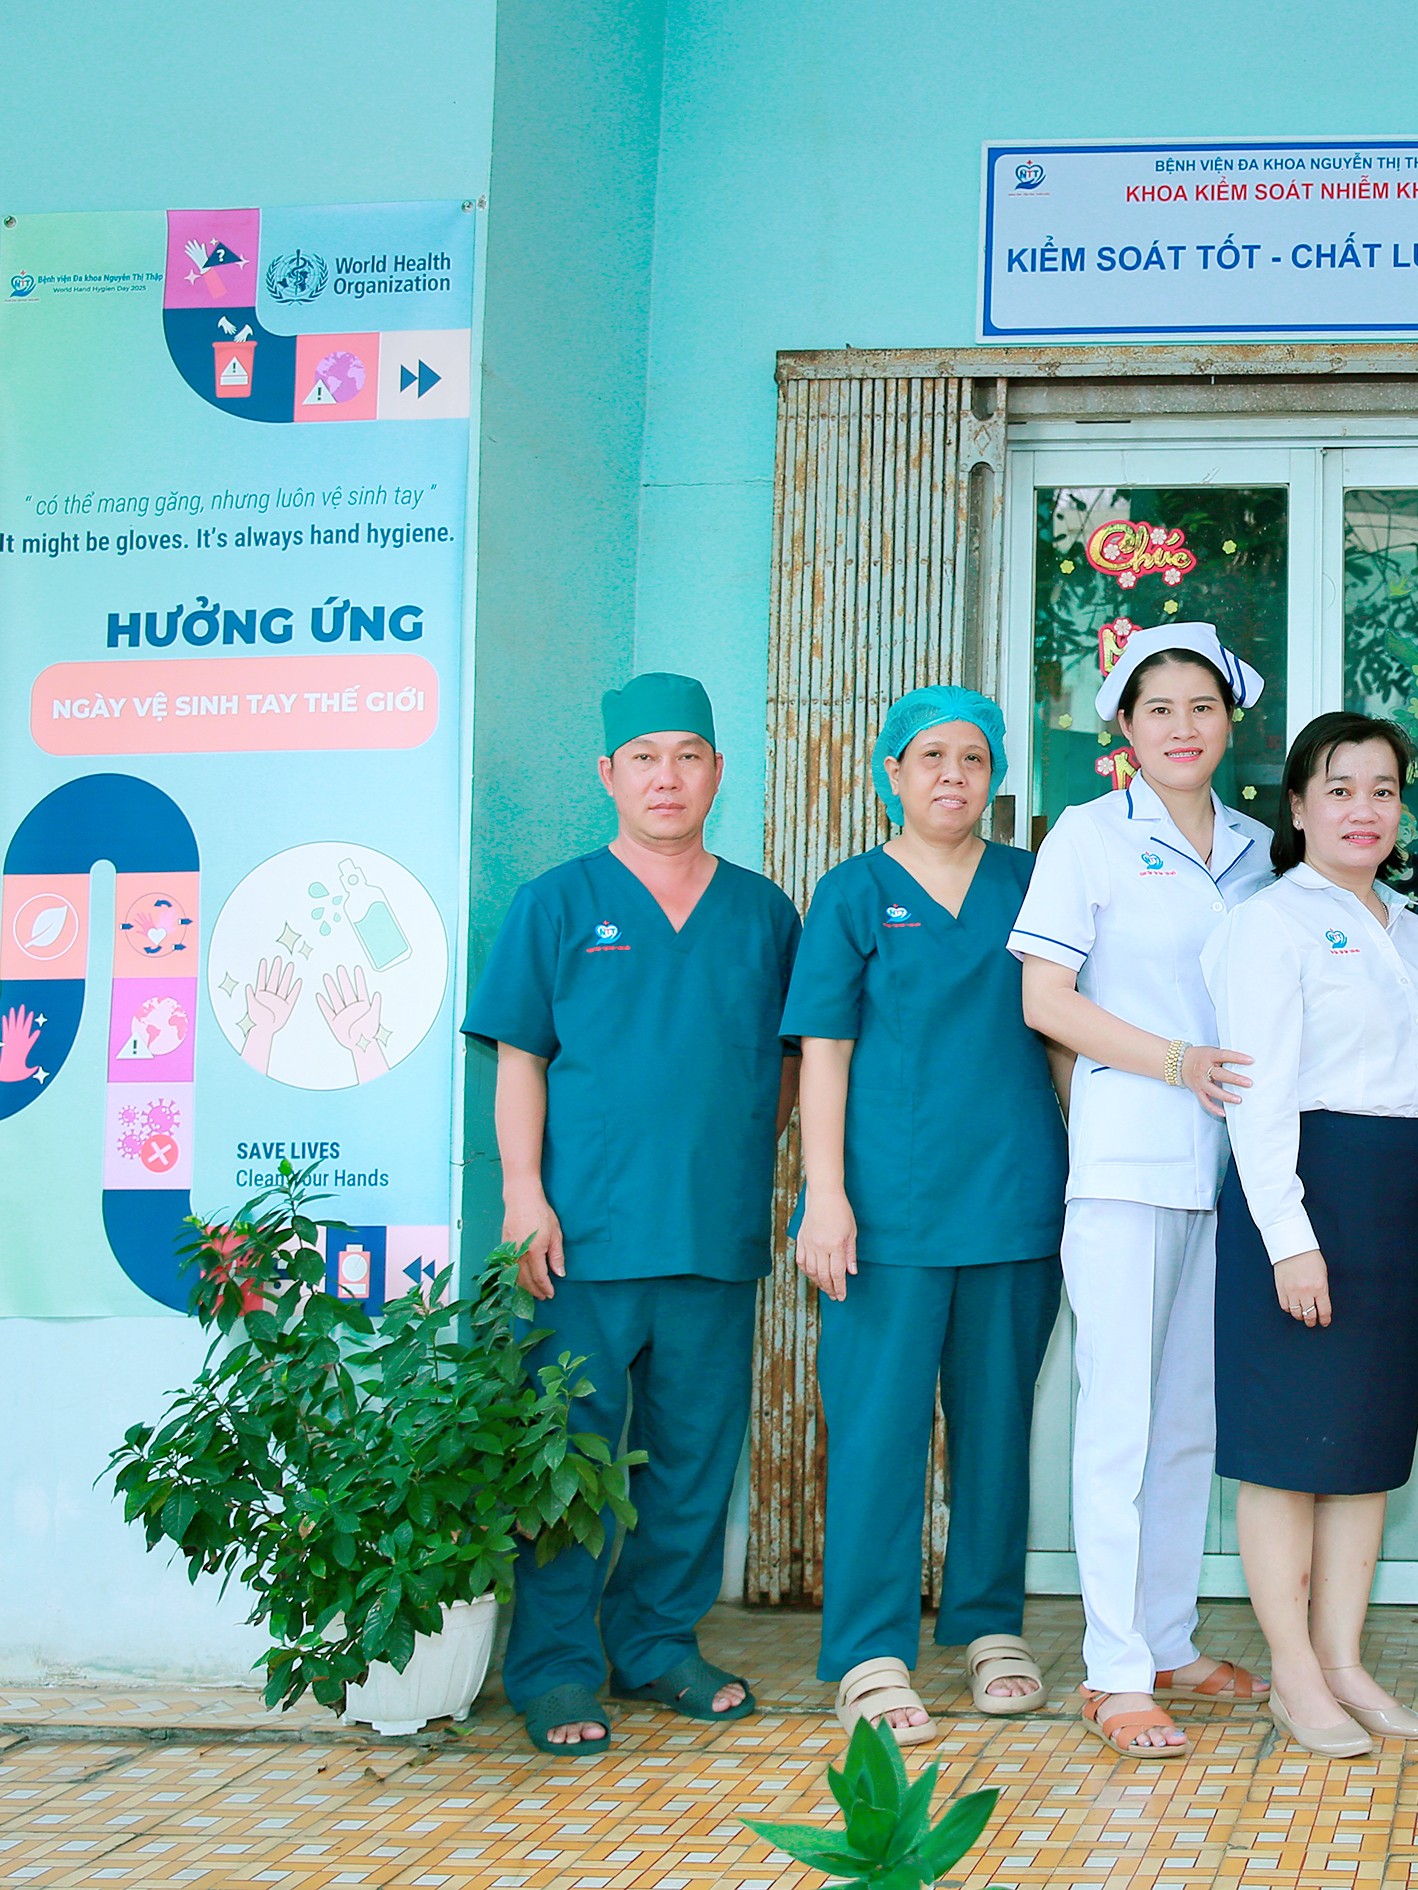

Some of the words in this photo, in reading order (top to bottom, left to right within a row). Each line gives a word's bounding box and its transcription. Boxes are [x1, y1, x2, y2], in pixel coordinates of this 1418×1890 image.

[1155, 157, 1196, 175] BỆNH
[1200, 156, 1234, 174] VIỆN
[1238, 158, 1259, 171] ĐA
[1263, 158, 1306, 171] KHOA
[1311, 153, 1373, 169] NGUYỄN
[1377, 156, 1401, 172] THỊ
[1126, 184, 1188, 202] KHOA
[1195, 175, 1248, 202] KIỂM
[1255, 179, 1314, 201] SOÁT
[1321, 174, 1389, 200] NHIỄM
[335, 254, 387, 275] World
[393, 251, 451, 273] Health
[1006, 234, 1086, 273] KIỂM
[1096, 240, 1187, 271] SOÁT
[1196, 233, 1262, 270] TỐT
[1291, 231, 1382, 269] CHẤT
[74, 285, 91, 293] Hand
[117, 285, 130, 293] Day
[131, 284, 147, 292] 2025
[333, 273, 451, 299] Organization
[36, 494, 58, 516] có
[64, 491, 95, 515] thể
[97, 496, 150, 518] mang
[154, 490, 205, 517] găng,
[211, 488, 271, 514] nhưng
[275, 487, 316, 508] luôn
[322, 485, 343, 510] vệ
[347, 484, 388, 506] sinh
[394, 485, 425, 510] tay
[0, 532, 15, 553] It
[22, 531, 80, 558] might
[86, 530, 110, 552] be
[116, 528, 190, 556] gloves.
[196, 526, 229, 549] It's
[234, 525, 304, 552] always
[310, 522, 360, 546] hand
[366, 522, 455, 549] hygiene.
[1088, 522, 1193, 573] Chúc
[106, 595, 295, 649] HƯỞNG
[310, 595, 425, 643] ỨNG
[52, 692, 128, 720] NGÀY
[132, 691, 169, 722] VỆ
[175, 694, 239, 717] SINH
[246, 692, 299, 715] TAY
[303, 685, 362, 713] THẾ
[366, 686, 425, 713] GIỚI
[236, 1141, 286, 1160] SAVE
[290, 1141, 341, 1160] LIVES
[236, 1168, 285, 1188] Clean
[289, 1169, 330, 1188] our
[334, 1168, 390, 1188] Hands
